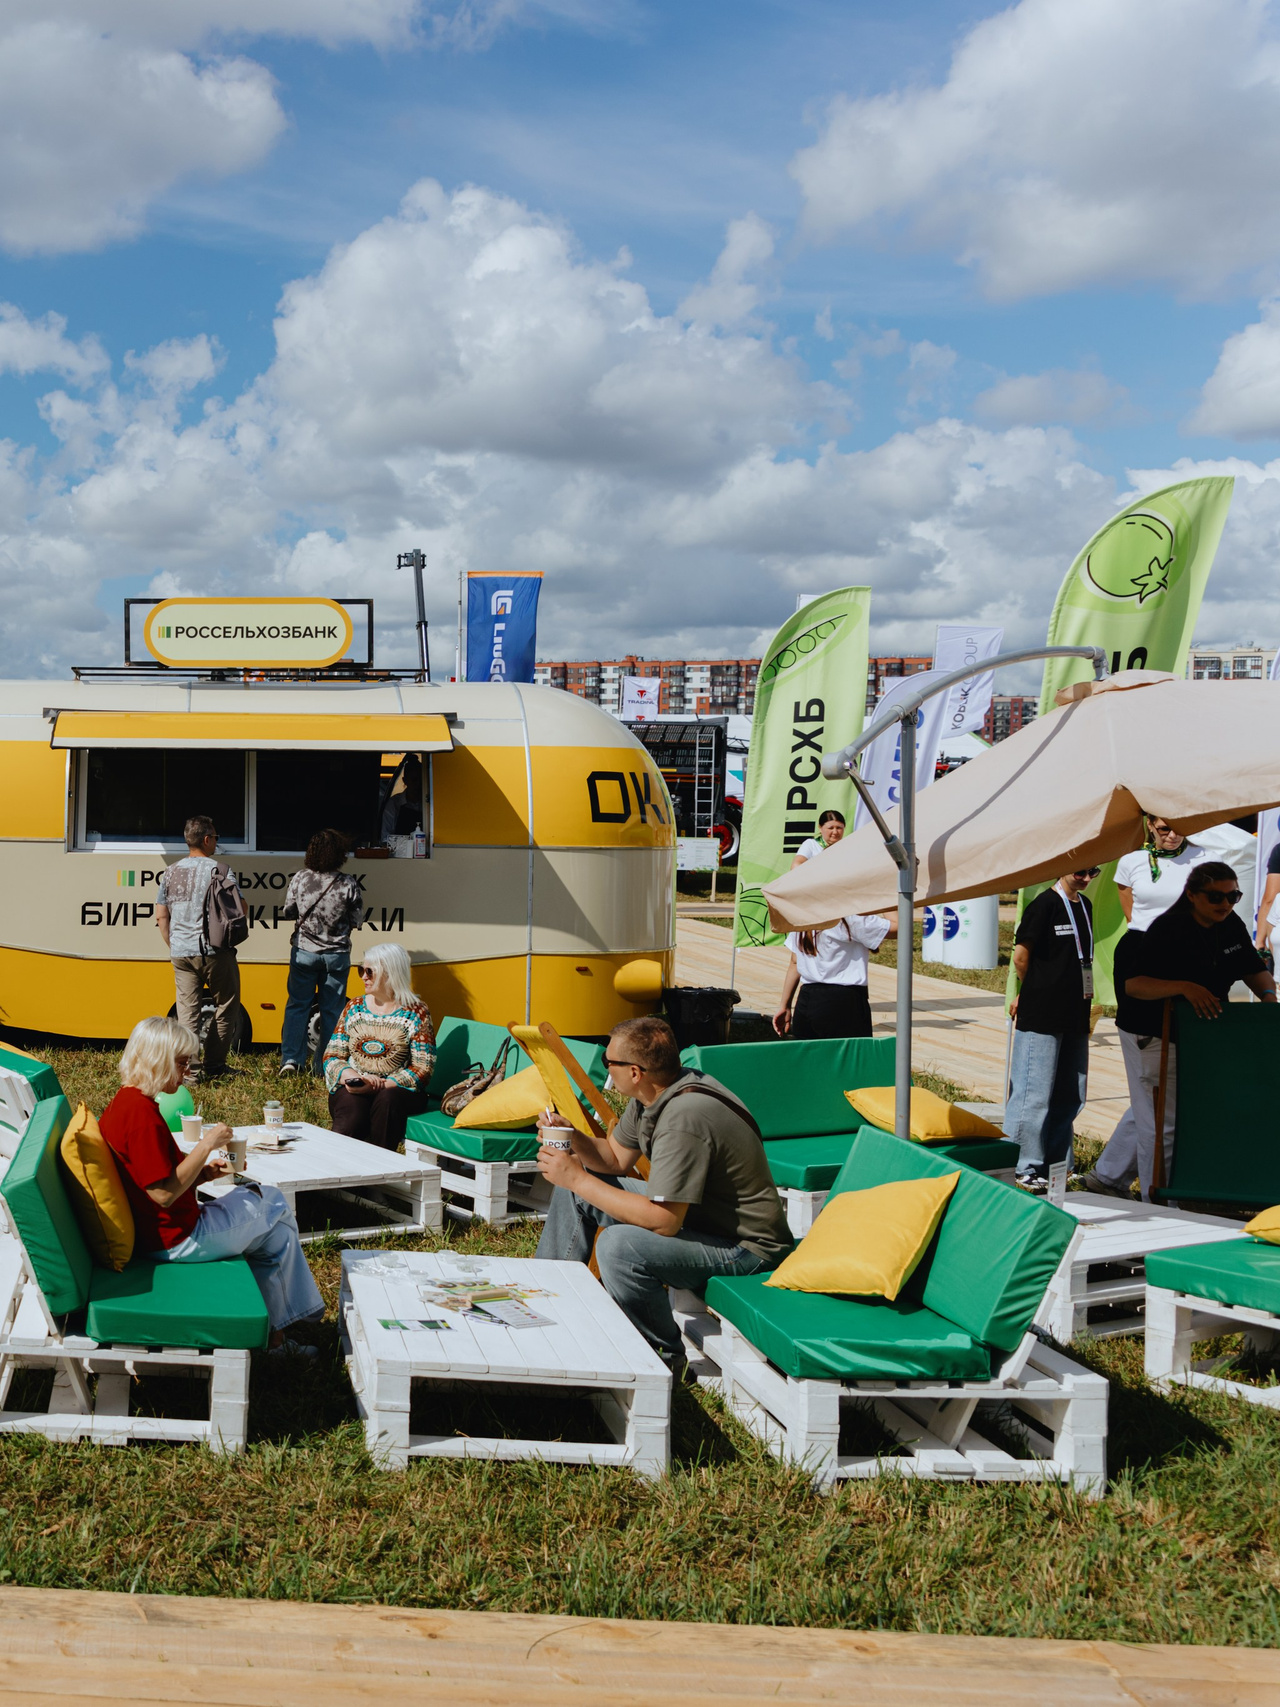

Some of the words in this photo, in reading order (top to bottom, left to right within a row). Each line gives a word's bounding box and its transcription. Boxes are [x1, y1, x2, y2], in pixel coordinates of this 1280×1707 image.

[174, 625, 339, 639] РОССЕЛЬХОЗБАНК
[786, 698, 825, 811] РСХБ
[586, 770, 672, 825] ОК
